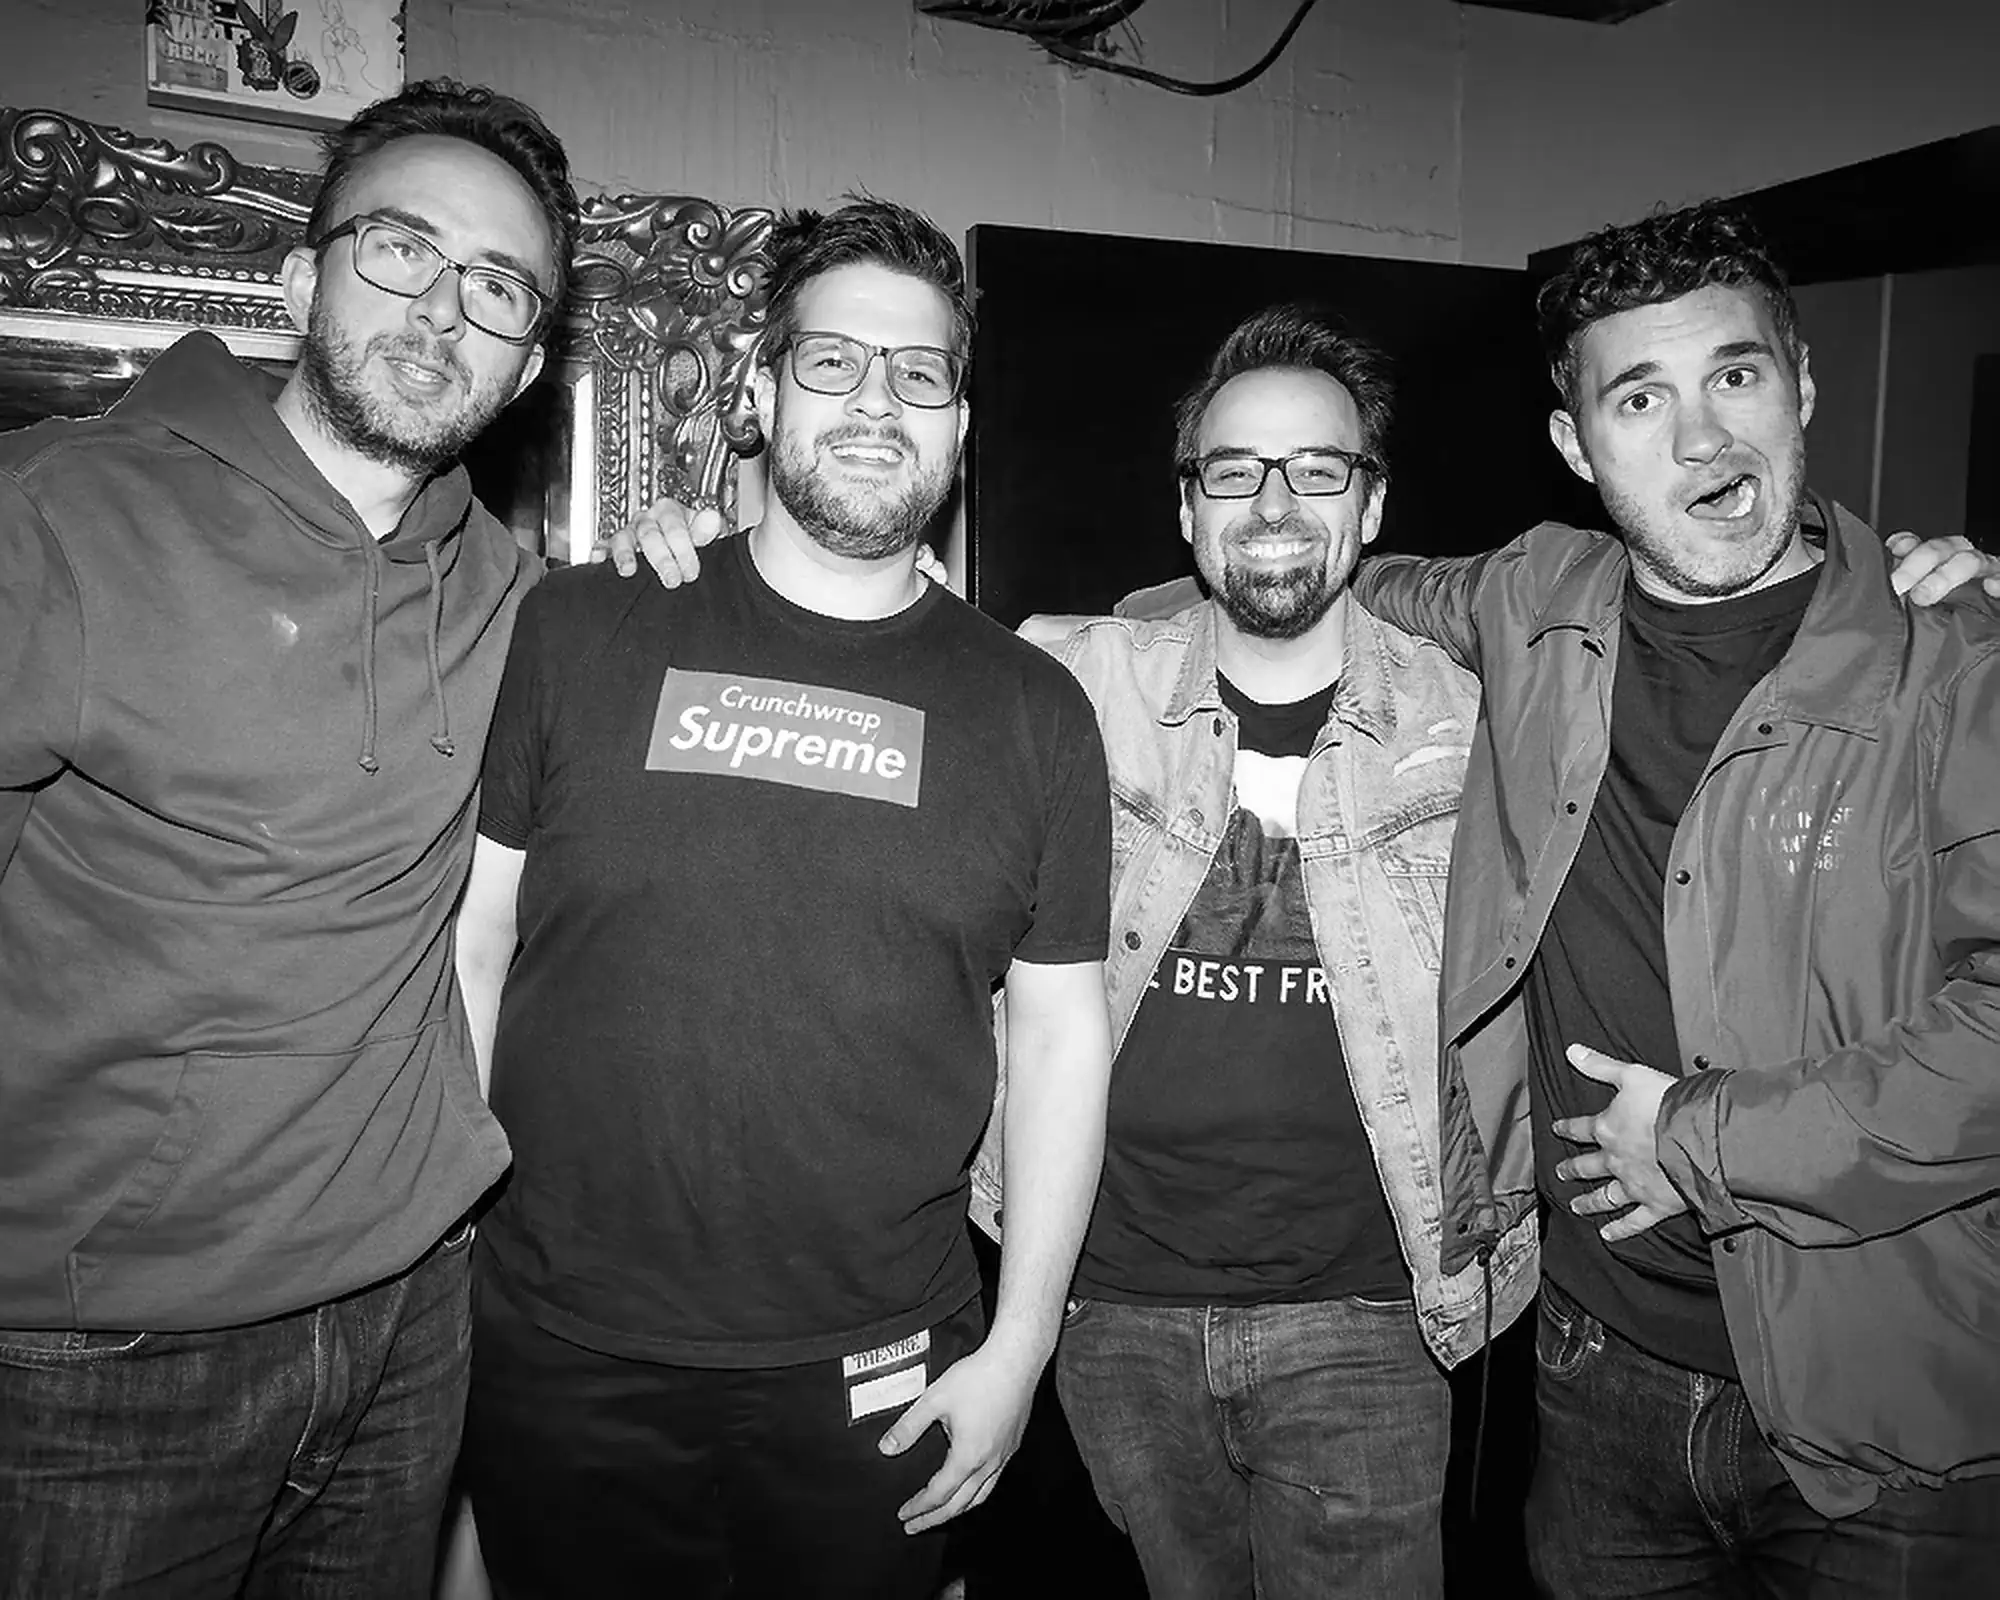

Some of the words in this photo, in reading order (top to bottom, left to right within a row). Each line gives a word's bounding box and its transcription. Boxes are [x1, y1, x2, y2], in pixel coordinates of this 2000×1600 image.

[719, 685, 881, 734] Crunchwrap
[669, 705, 907, 779] Supreme
[1173, 957, 1265, 1004] BEST
